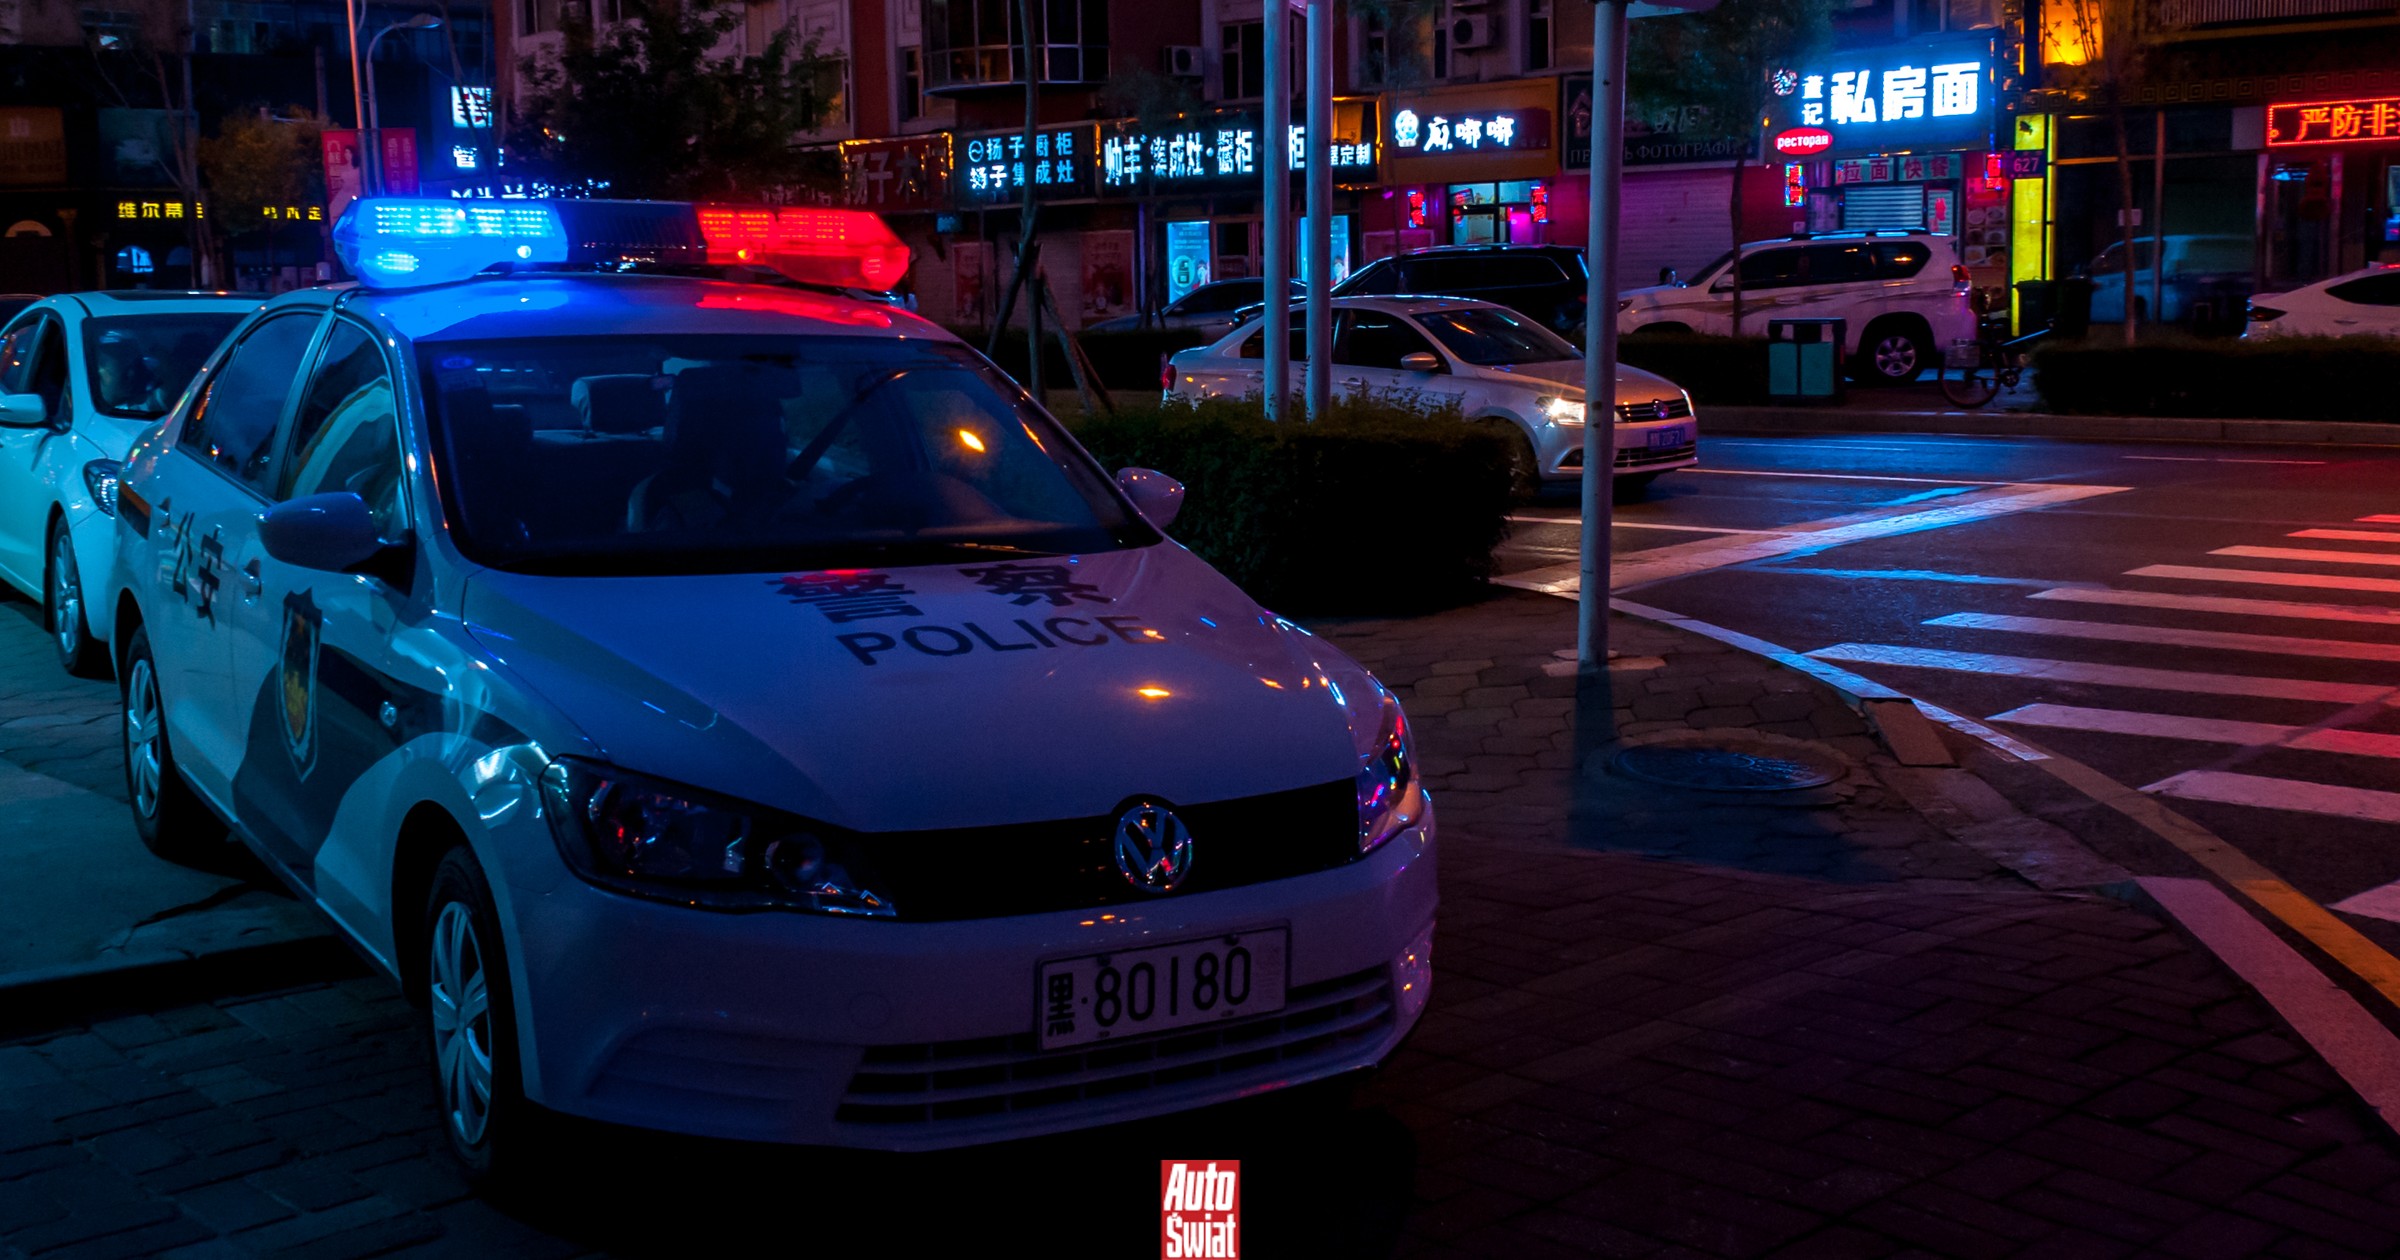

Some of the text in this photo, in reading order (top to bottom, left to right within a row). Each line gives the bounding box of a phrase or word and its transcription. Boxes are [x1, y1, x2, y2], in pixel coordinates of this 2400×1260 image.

[1831, 63, 1981, 125] 私房面
[2296, 103, 2400, 141] 严防非
[1777, 135, 1830, 151] ресторан
[1843, 156, 1950, 182] 拉面 快餐
[2014, 157, 2039, 172] 627
[837, 616, 1167, 666] POLICE
